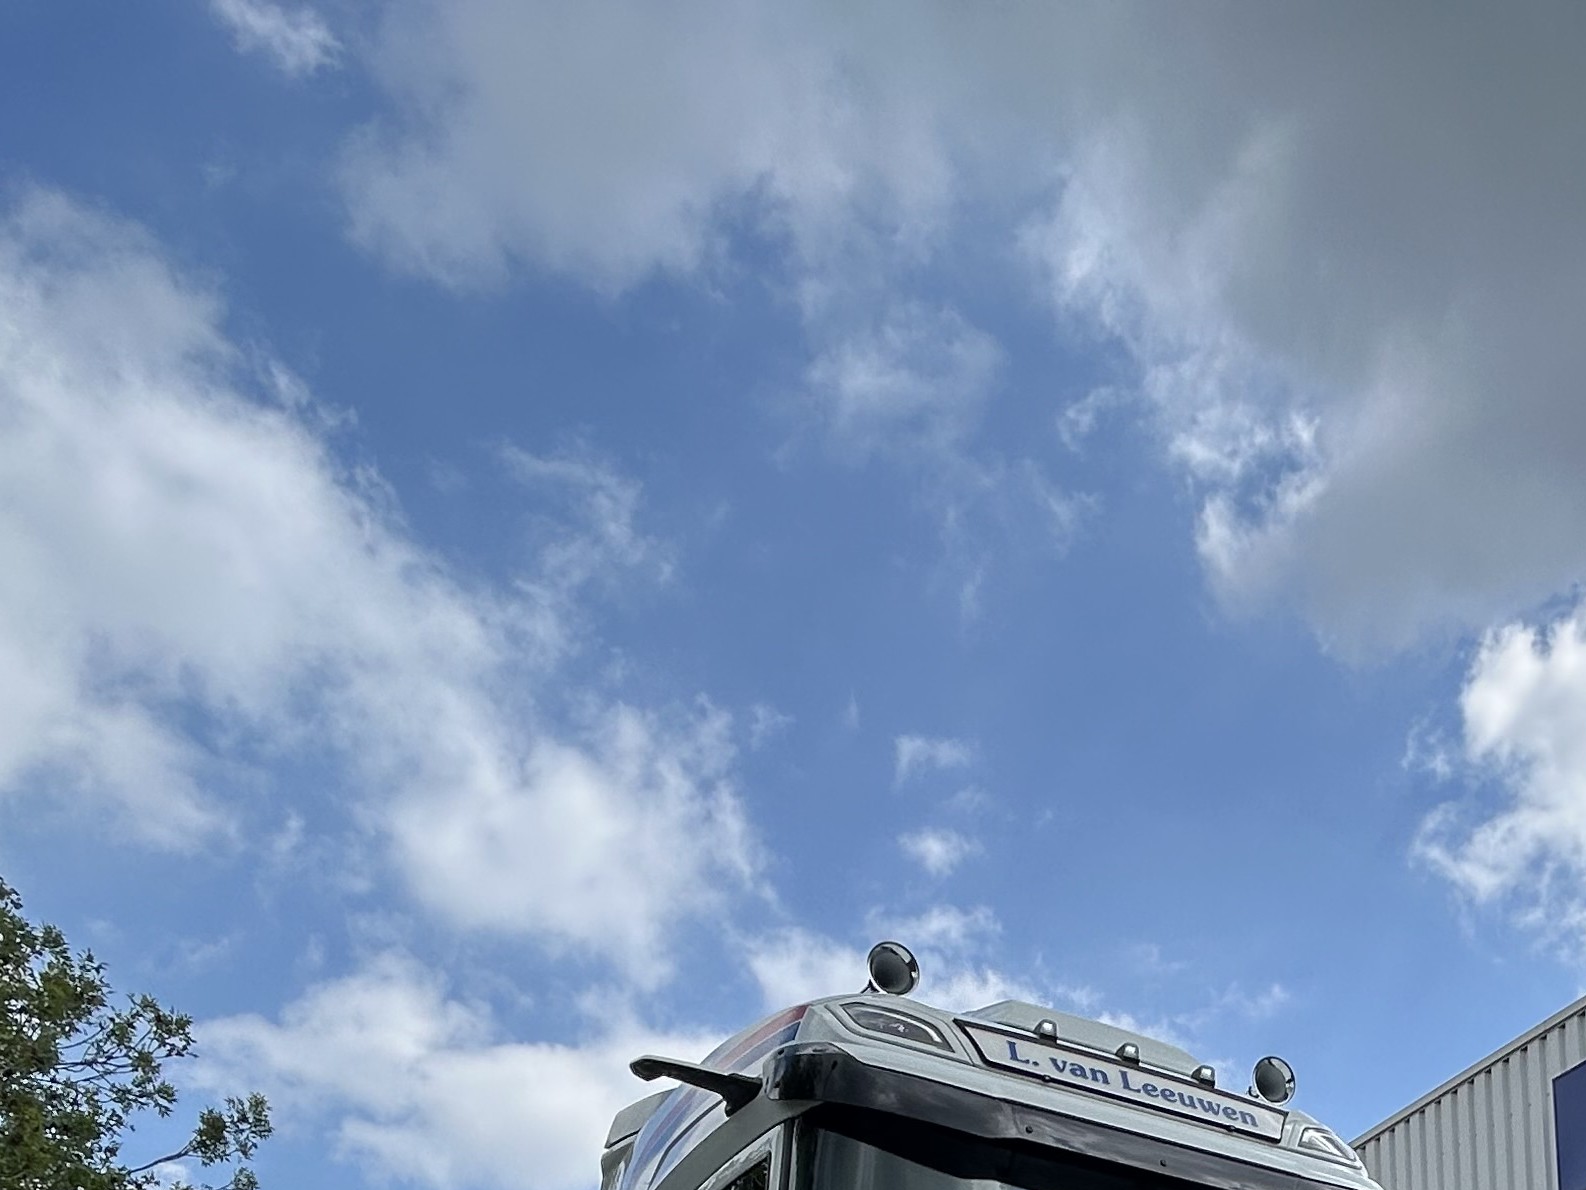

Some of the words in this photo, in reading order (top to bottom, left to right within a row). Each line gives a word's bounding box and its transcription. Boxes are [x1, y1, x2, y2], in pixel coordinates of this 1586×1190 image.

[1006, 1040, 1040, 1067] L.
[1048, 1056, 1111, 1085] van
[1118, 1069, 1259, 1128] Leeuwen
